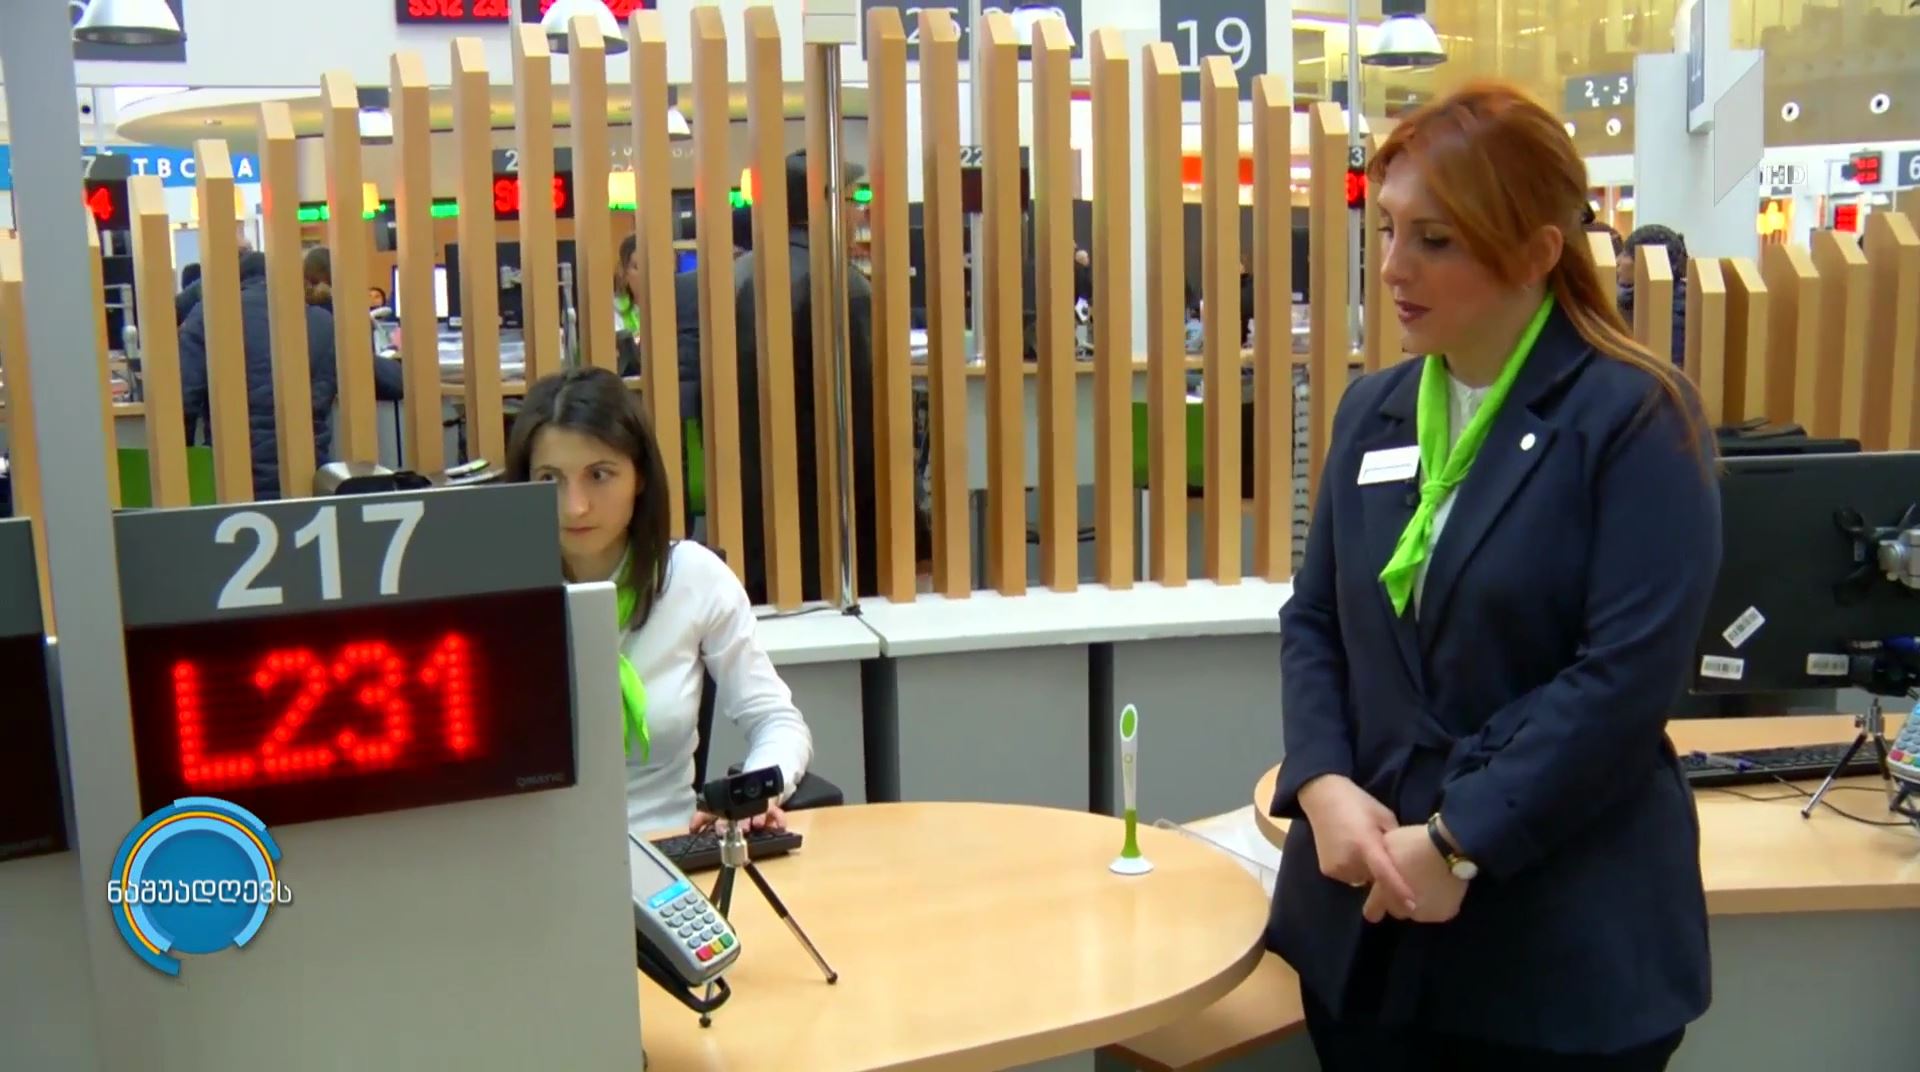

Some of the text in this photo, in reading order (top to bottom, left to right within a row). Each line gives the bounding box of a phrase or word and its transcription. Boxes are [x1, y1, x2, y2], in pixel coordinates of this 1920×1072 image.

[1174, 16, 1252, 73] 19
[1585, 80, 1594, 98] 2
[1618, 76, 1628, 94] 5
[960, 147, 983, 168] 22
[1351, 147, 1363, 168] 3
[214, 501, 425, 609] 217
[171, 631, 477, 783] L231
